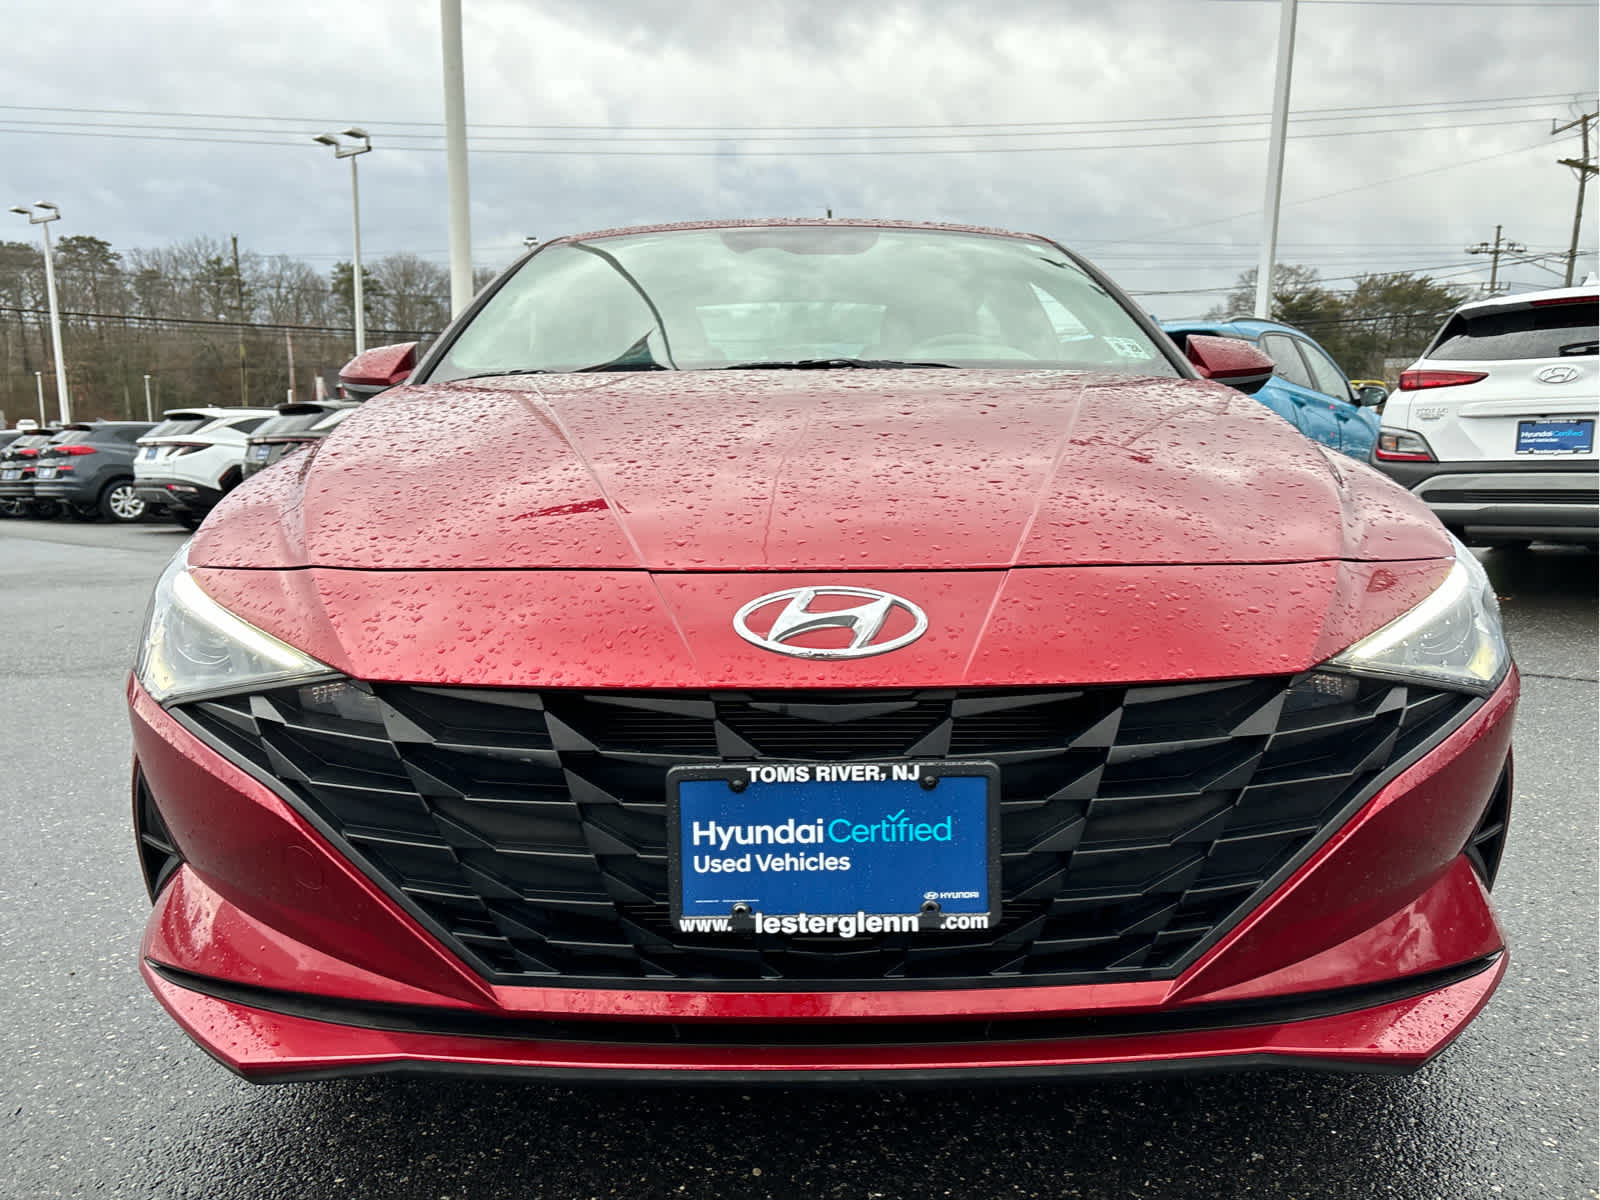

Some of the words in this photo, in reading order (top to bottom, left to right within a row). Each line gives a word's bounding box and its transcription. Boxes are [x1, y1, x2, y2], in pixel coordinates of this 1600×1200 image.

[746, 765, 810, 783] TOMS
[815, 763, 888, 782] RIVER,
[892, 763, 920, 781] NJ
[692, 818, 824, 851] Hyundai
[827, 809, 953, 844] Certified
[693, 853, 751, 874] Used
[755, 852, 851, 872] Vehicles
[939, 891, 980, 899] HYUNDAI
[679, 915, 733, 933] www.
[754, 911, 920, 938] lesterglenn
[940, 912, 989, 932] .com
